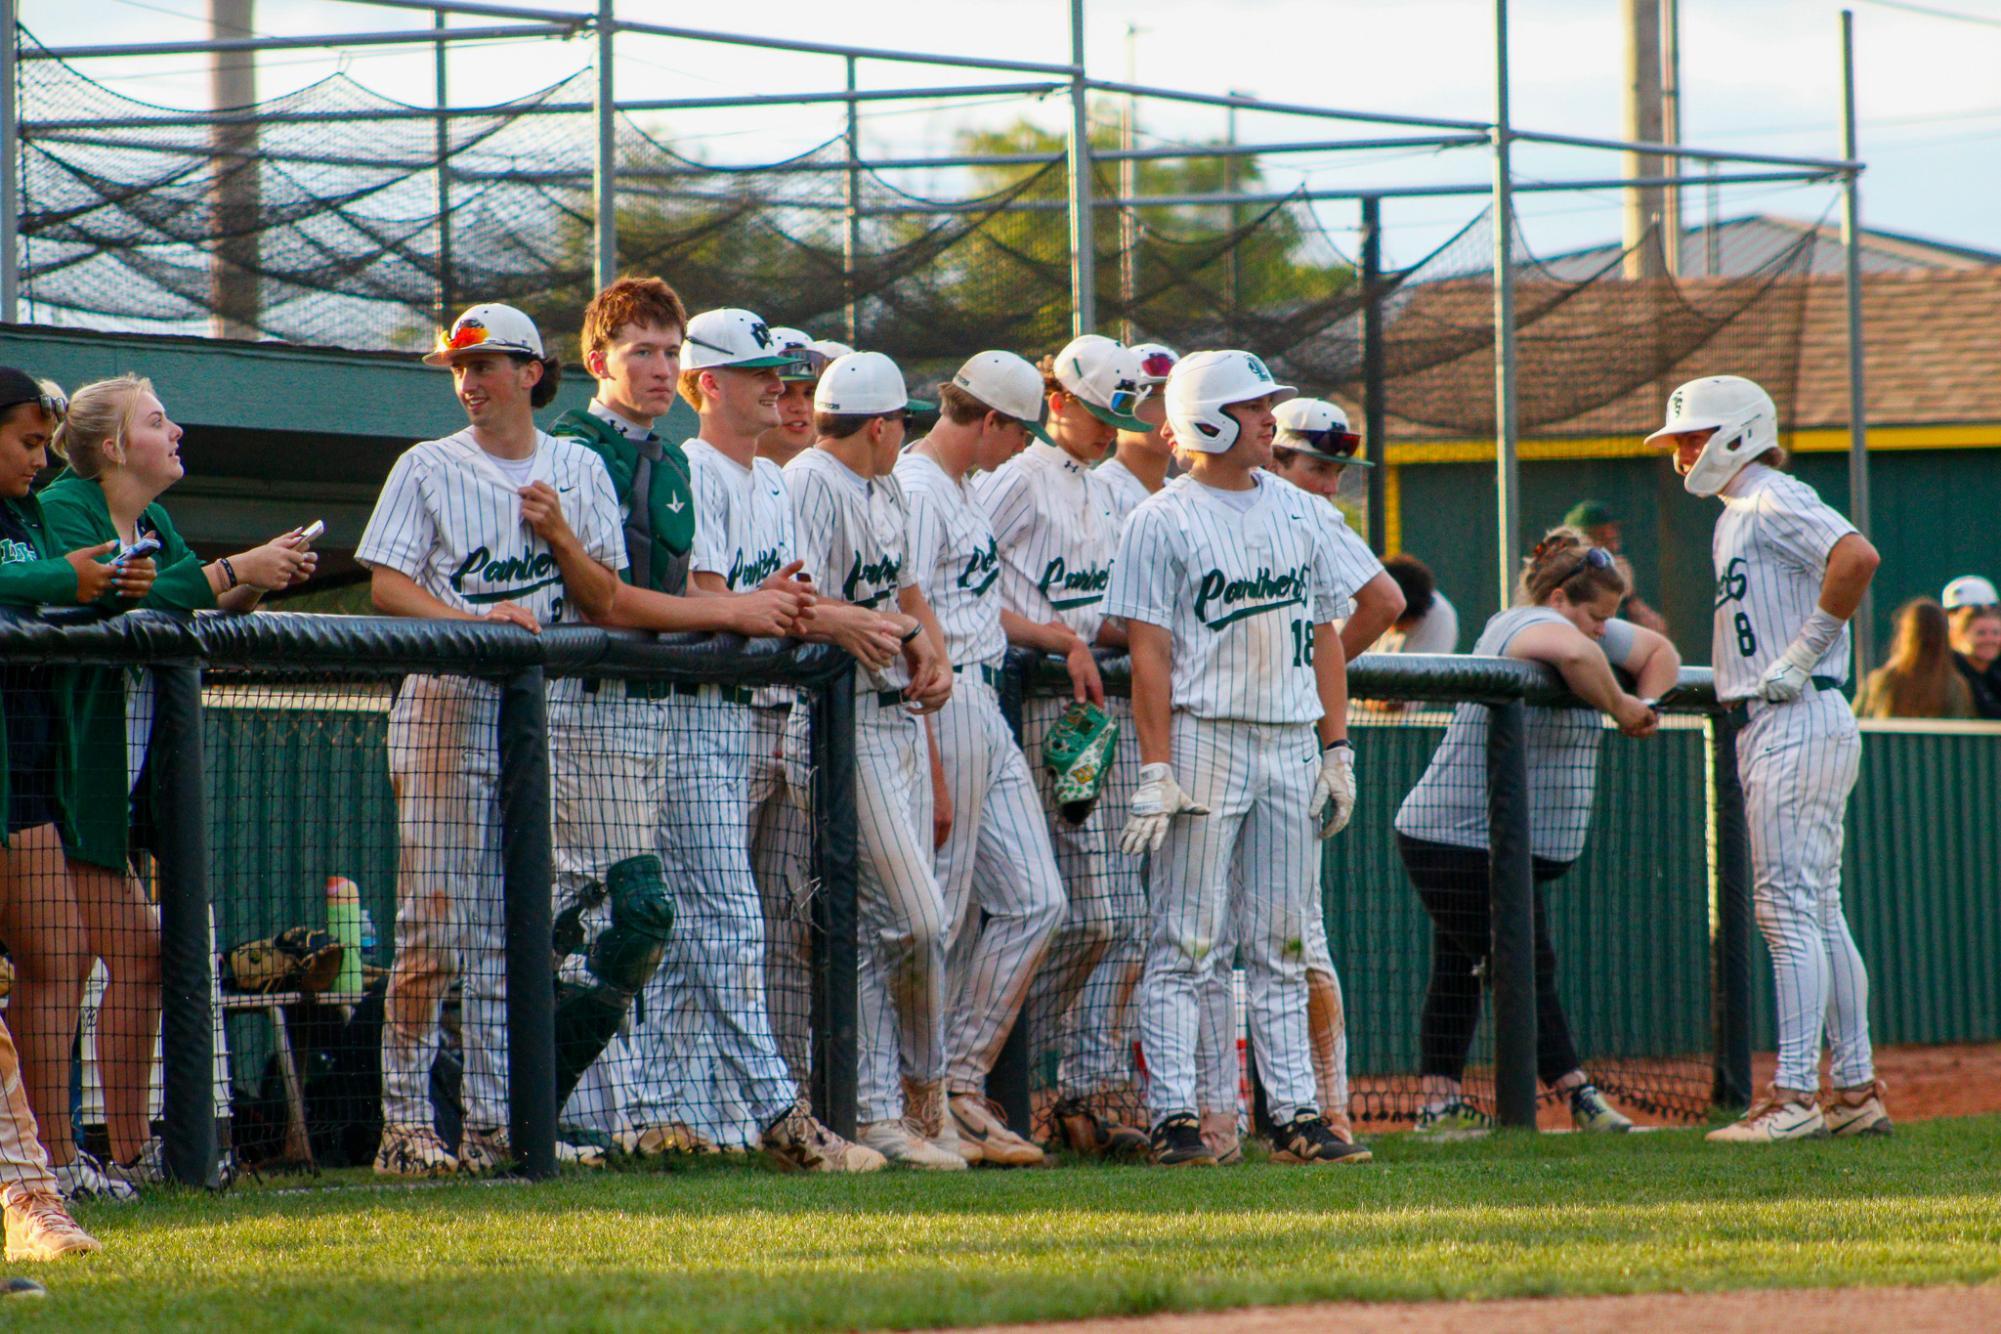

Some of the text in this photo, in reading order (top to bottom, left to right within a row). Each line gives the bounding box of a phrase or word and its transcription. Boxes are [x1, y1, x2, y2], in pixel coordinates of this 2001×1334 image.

[1194, 562, 1311, 623] Panthers
[1291, 618, 1314, 668] 18
[1734, 612, 1756, 657] 8
